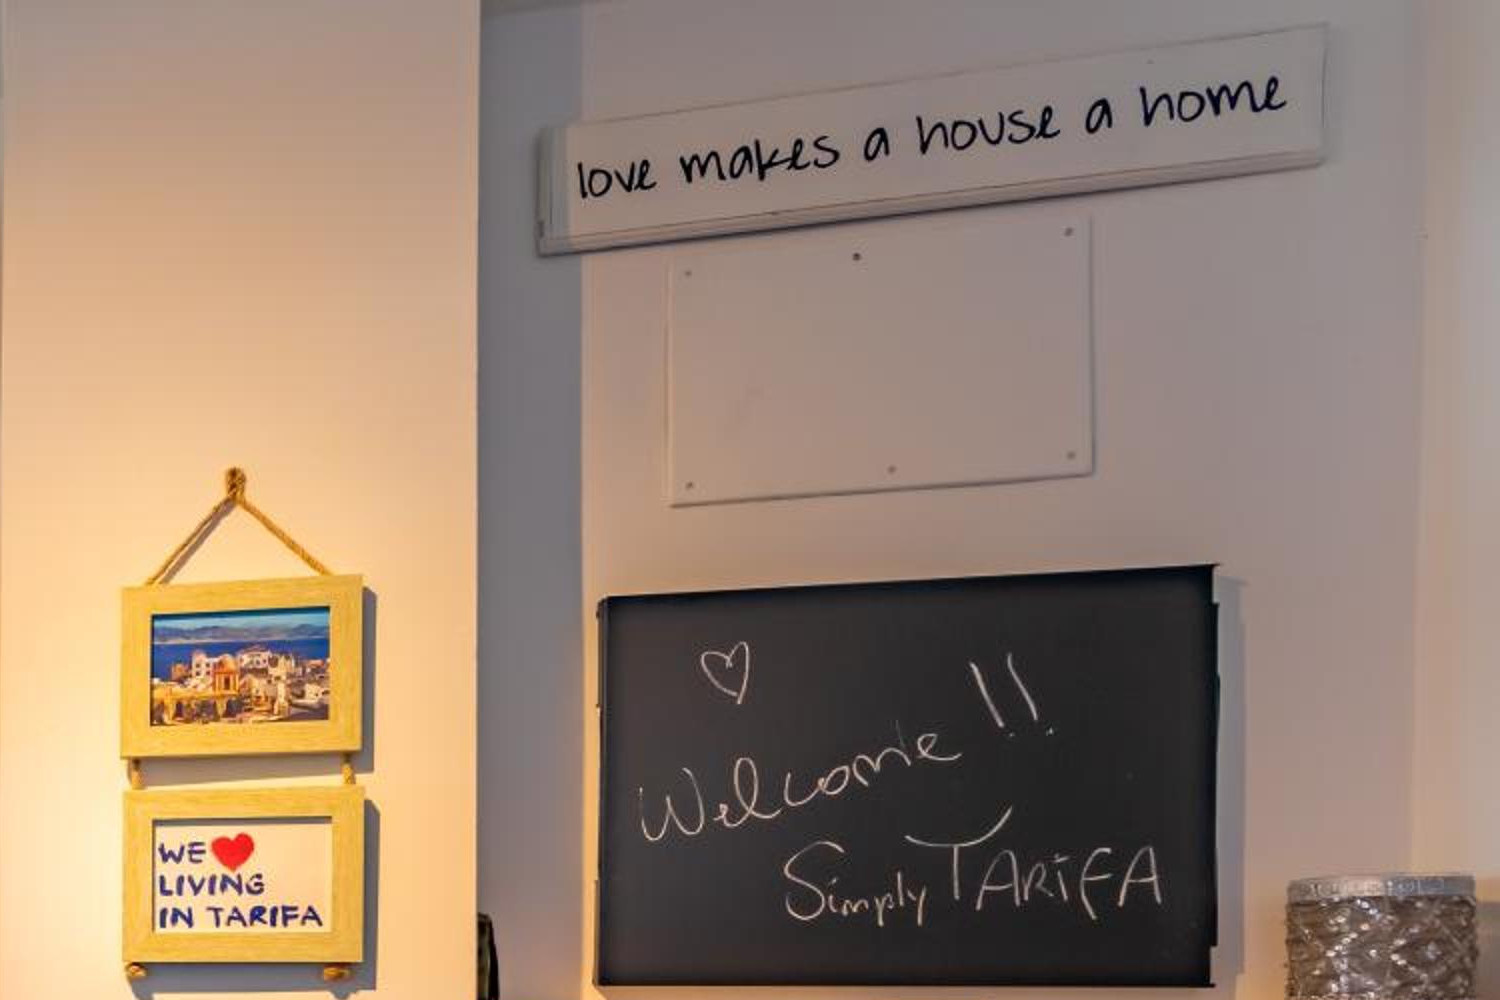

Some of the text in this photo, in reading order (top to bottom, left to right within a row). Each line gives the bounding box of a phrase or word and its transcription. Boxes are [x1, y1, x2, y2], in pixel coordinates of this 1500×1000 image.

[577, 75, 1287, 200] love makes a house a home
[638, 732, 963, 842] Welcome
[159, 841, 206, 864] WE
[159, 874, 265, 896] LIVING
[783, 841, 927, 927] Simply
[159, 905, 323, 928] IN TARIFA
